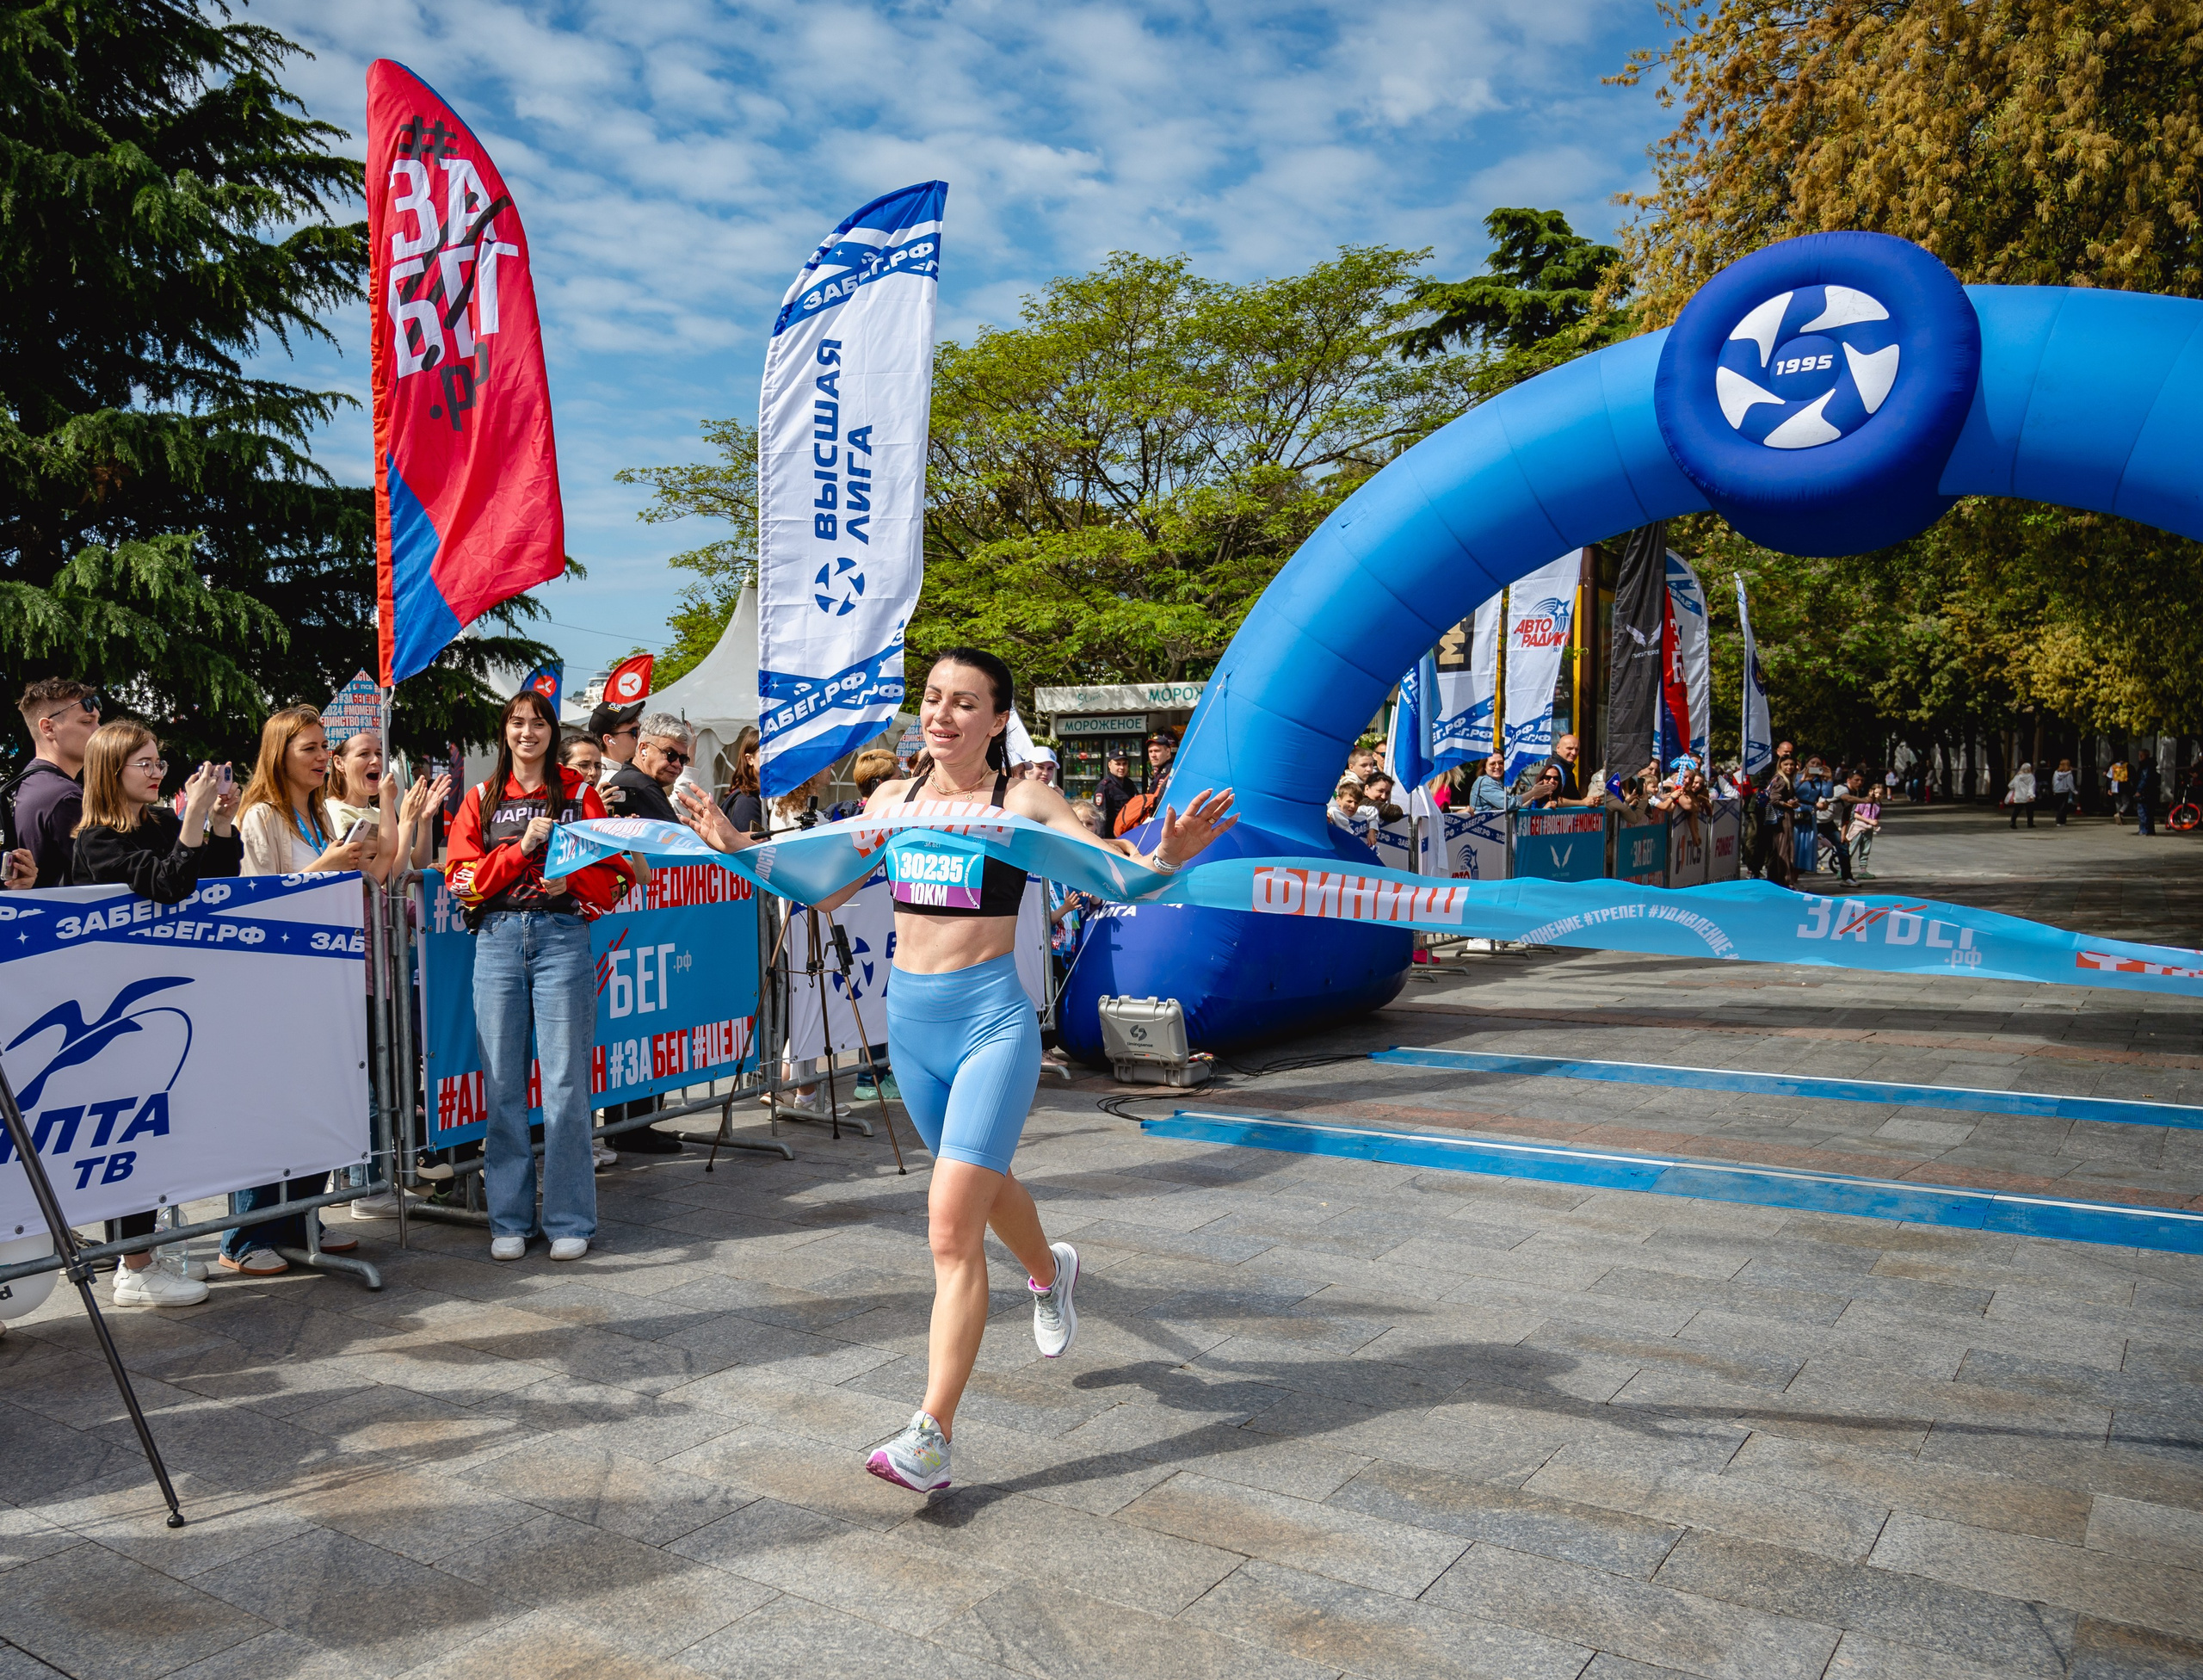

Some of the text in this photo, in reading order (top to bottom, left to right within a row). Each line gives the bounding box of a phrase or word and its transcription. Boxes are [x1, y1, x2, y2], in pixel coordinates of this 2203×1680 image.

[388, 158, 497, 261] ЗА
[1776, 354, 1833, 376] 1995
[814, 338, 842, 541] ВЫСШАЯ
[846, 424, 873, 546] ЛИГА
[1514, 618, 1552, 634] АВТО
[339, 693, 366, 704] #ЗАБЕГ
[343, 705, 377, 716] #МОМЕНТ
[759, 671, 867, 741] АБЕГ.РФ
[1064, 718, 1142, 732] МОРОЖЕНОЕ
[1543, 813, 1575, 835] #ВОСТОРГ
[646, 863, 753, 911] #ЕДИНСТВО
[900, 852, 964, 883] 30235
[1253, 867, 1470, 924] ФИНИШ
[1583, 904, 1646, 926] #ТРЕПЕТ
[1648, 904, 1734, 956] #УДИВЛЕНИЕ
[1944, 946, 1982, 970] .рф
[608, 942, 693, 1020] БЕГ .рф
[610, 1028, 688, 1090] #ЗАБЕГ
[693, 1016, 755, 1070] #ЦЕЛЬ
[73, 1151, 137, 1190] ТВ
